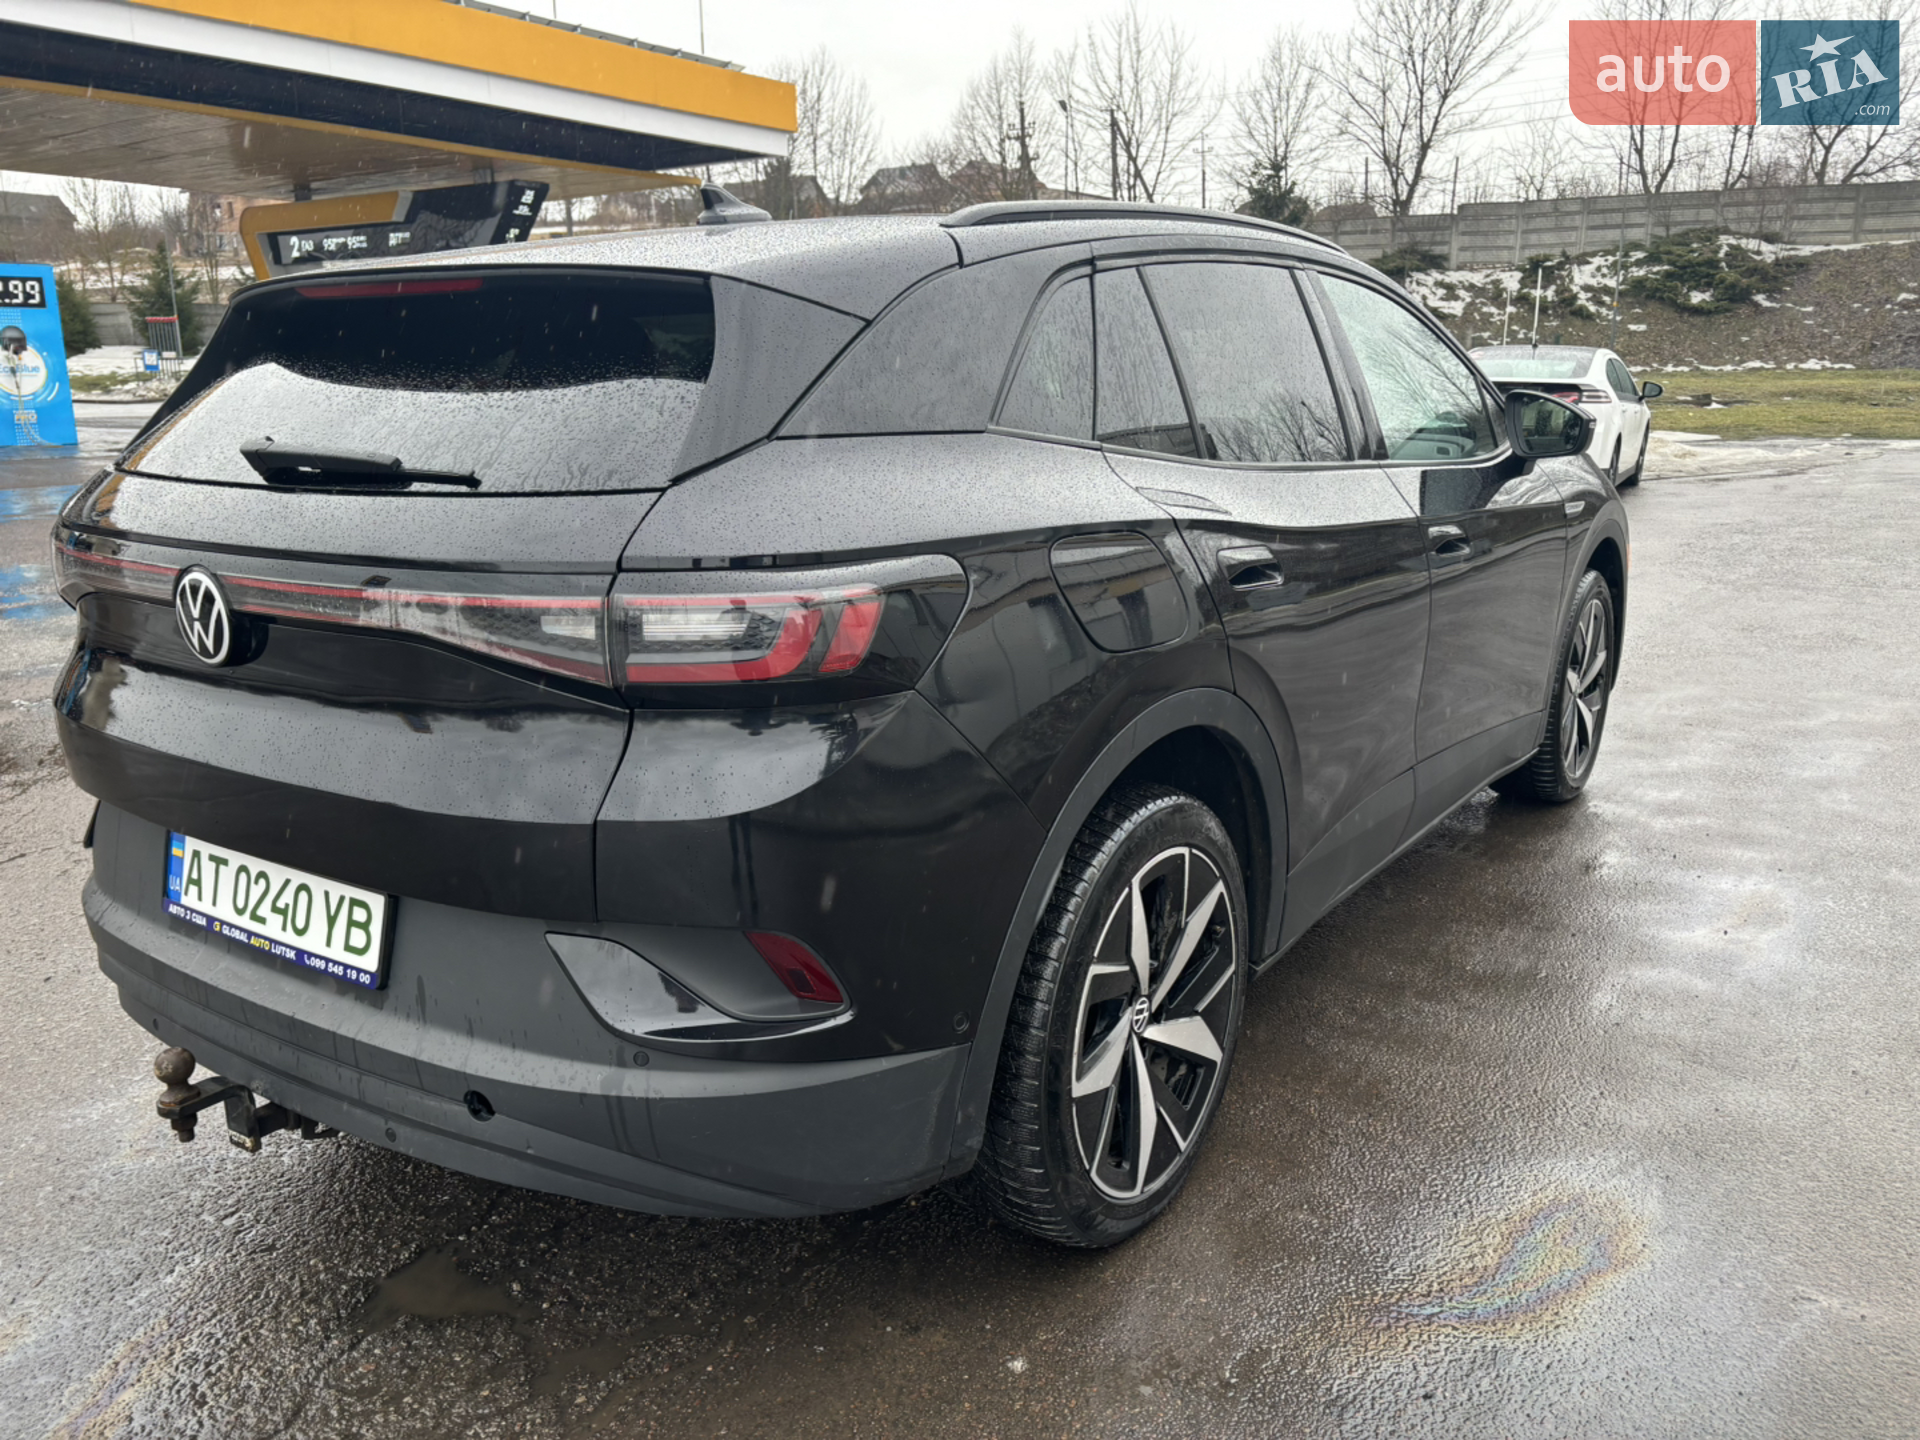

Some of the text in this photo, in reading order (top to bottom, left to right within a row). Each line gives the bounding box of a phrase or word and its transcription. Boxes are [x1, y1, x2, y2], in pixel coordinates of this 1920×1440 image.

[169, 875, 181, 893] UA
[191, 912, 207, 927] США
[222, 925, 249, 943] GLOBAL
[249, 934, 270, 951] AUTO
[271, 944, 297, 961] LUTSK
[310, 957, 371, 985] 099 545 19 00
